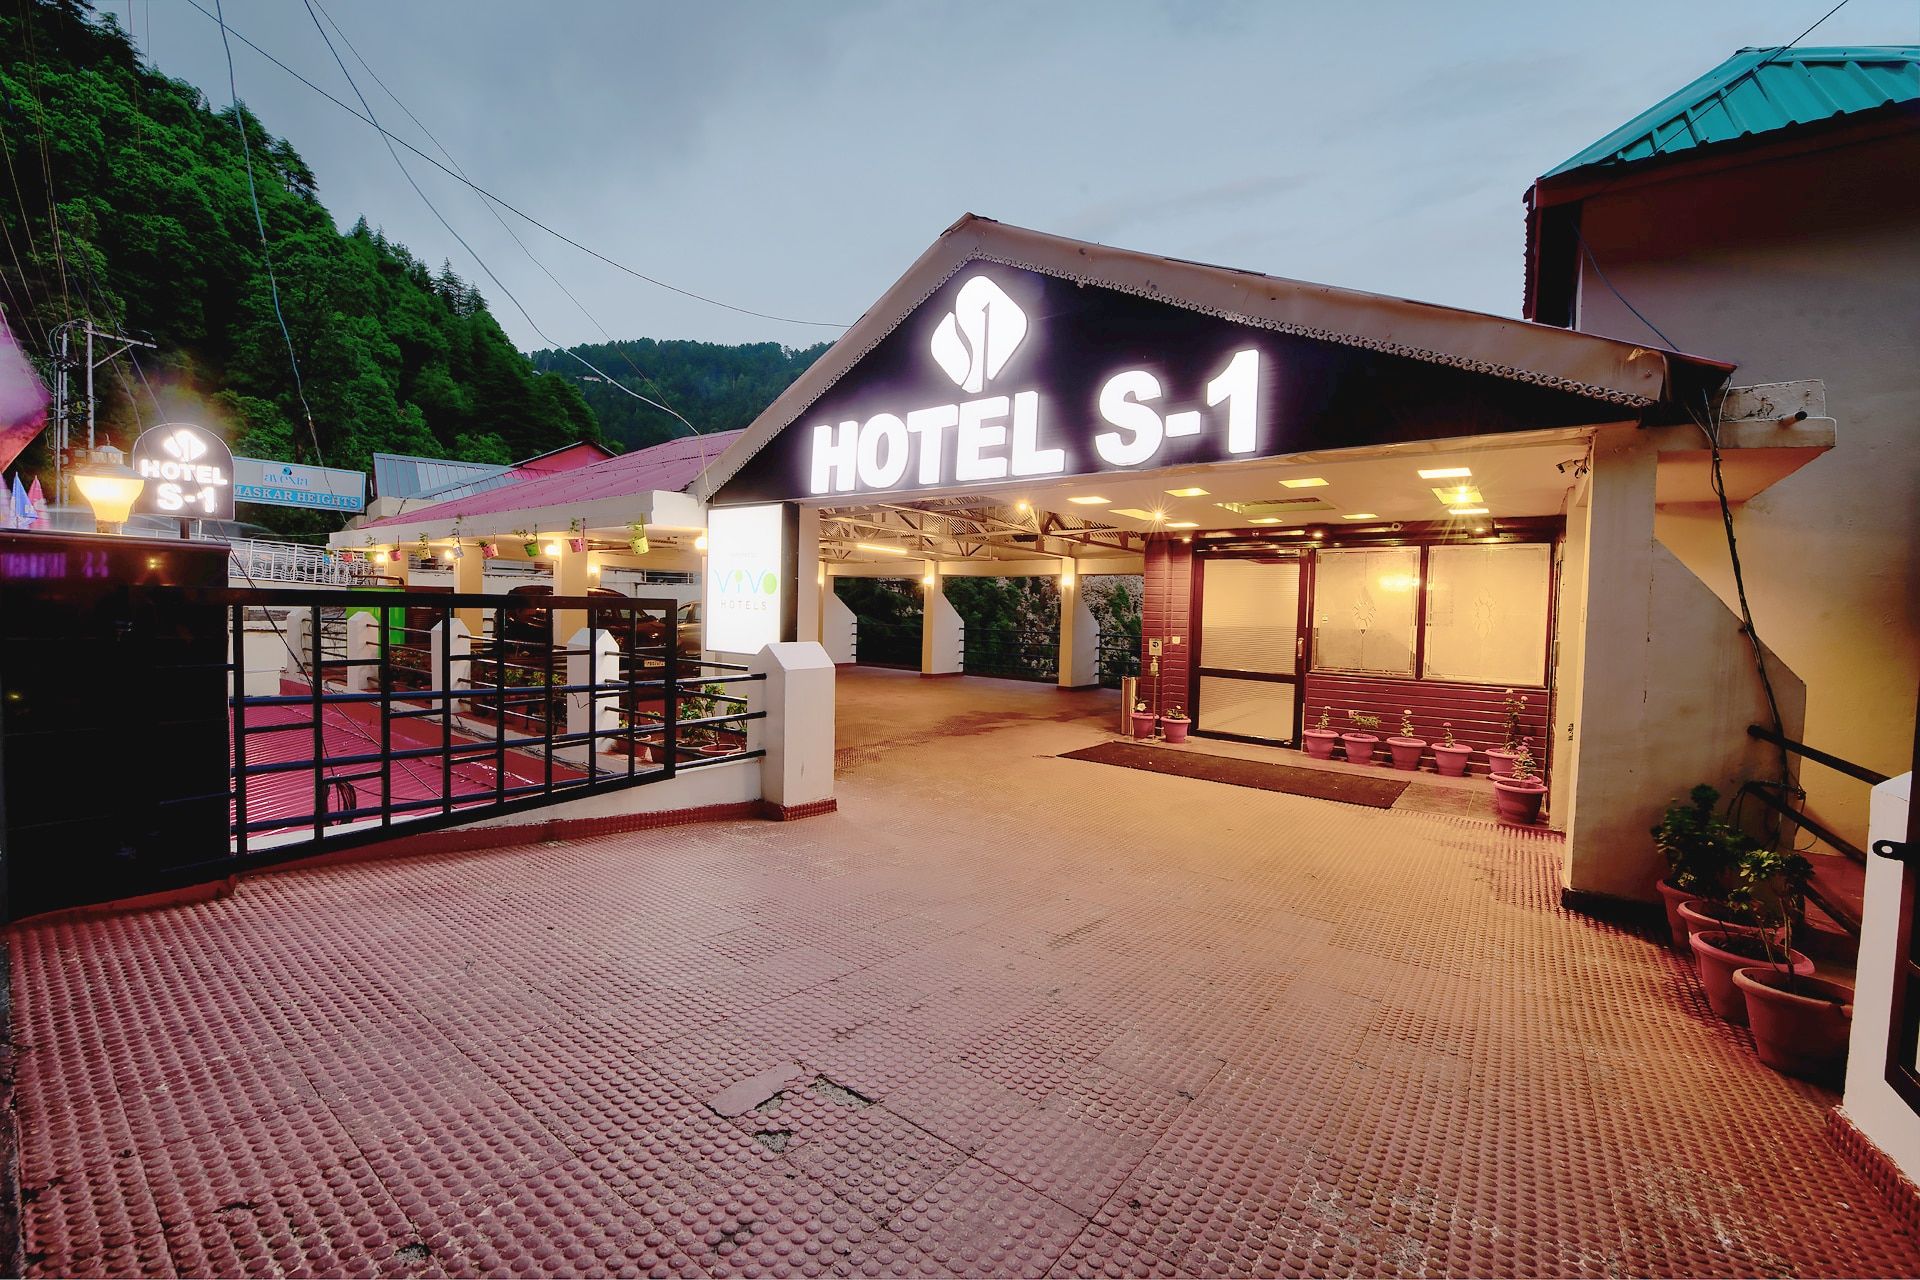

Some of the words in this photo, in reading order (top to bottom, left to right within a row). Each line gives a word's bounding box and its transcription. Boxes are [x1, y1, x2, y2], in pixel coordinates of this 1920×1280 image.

[810, 391, 1066, 494] HOTEL
[1094, 349, 1261, 467] S-1
[141, 459, 228, 485] HOTEL
[157, 483, 217, 513] S-1
[297, 493, 358, 507] HEIGHTS
[721, 601, 767, 610] HOTELS
